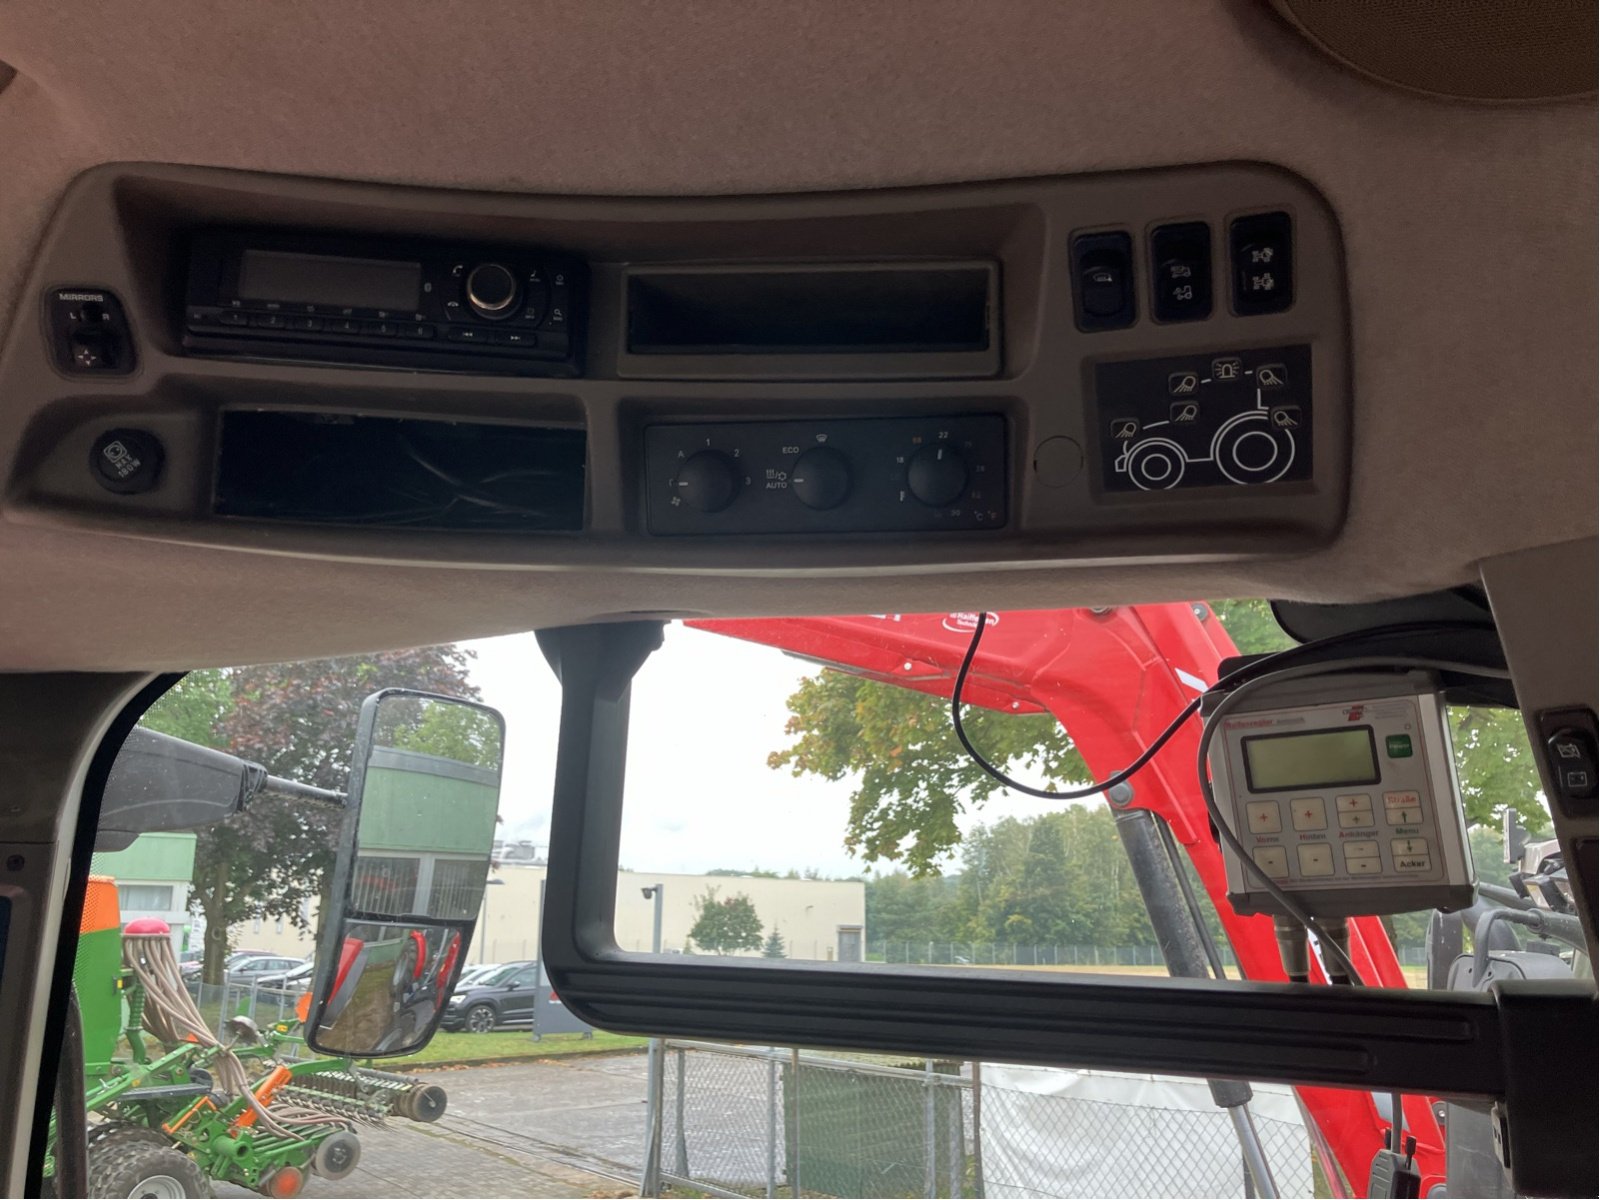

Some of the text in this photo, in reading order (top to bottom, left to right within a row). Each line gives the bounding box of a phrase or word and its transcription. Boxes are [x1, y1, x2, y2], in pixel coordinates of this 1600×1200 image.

[59, 293, 104, 302] MIRRORS
[69, 312, 77, 320] L
[102, 313, 110, 321] R
[938, 431, 949, 439] 22
[705, 437, 711, 447] 1
[733, 448, 741, 458] 2
[782, 446, 800, 454] ECO
[677, 450, 686, 459] A
[115, 453, 133, 469] MAX
[896, 456, 905, 464] 18
[744, 476, 752, 487] 3
[1387, 795, 1417, 804] Straße
[1299, 833, 1327, 841] Hinten
[1399, 861, 1426, 869] Acker
